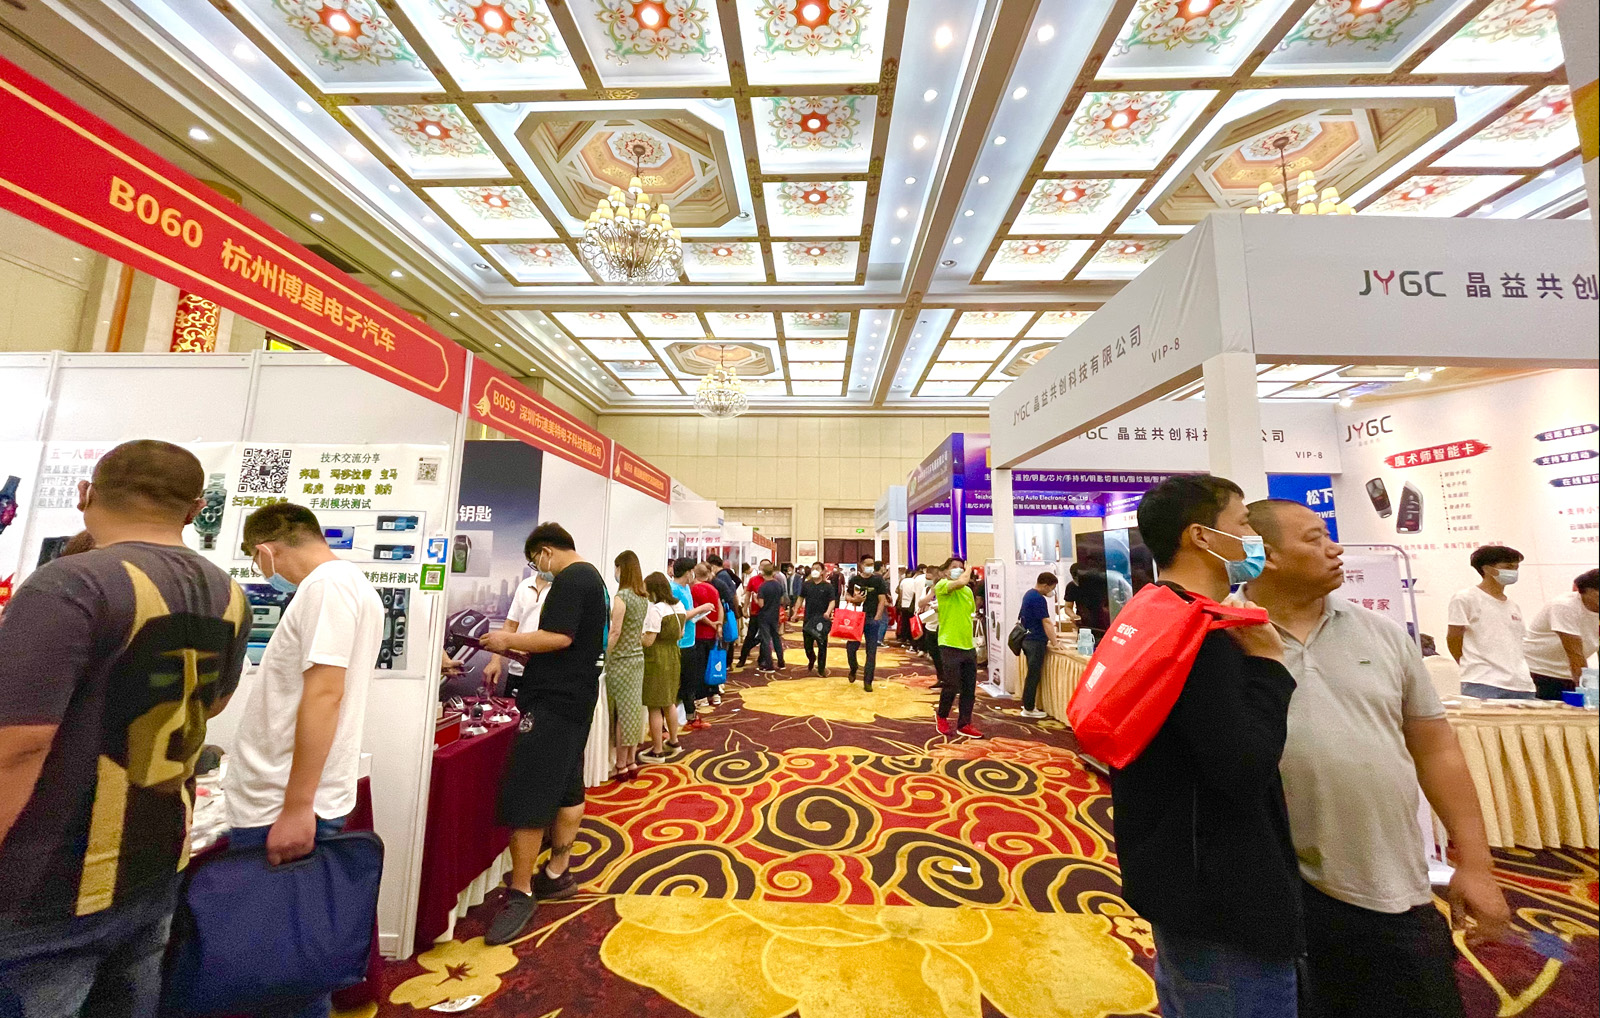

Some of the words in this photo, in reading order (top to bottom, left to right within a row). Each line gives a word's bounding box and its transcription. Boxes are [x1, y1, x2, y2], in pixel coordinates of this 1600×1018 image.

[108, 175, 203, 248] B060
[220, 238, 396, 353] 杭州博星电子汽车
[1359, 270, 1447, 297] JYGC
[1466, 271, 1599, 301] 晶益共创
[1151, 337, 1181, 363] VIP-8
[1013, 401, 1031, 426] JYGC
[1033, 324, 1142, 413] 晶益共创科技有限公司
[493, 389, 516, 414] B059
[1085, 426, 1109, 440] GC
[1345, 415, 1393, 442] JYGC
[320, 452, 381, 464] 技术交流分享
[1295, 451, 1324, 459] VIP-8
[1394, 443, 1474, 467] 魔术师智能卡
[299, 467, 320, 480] 奔驰
[379, 468, 398, 480] 宝马
[303, 482, 324, 495] 路虎
[334, 483, 366, 495] 保时捷
[1306, 487, 1333, 506] 松下
[309, 497, 371, 509] 手刹模块测试
[1039, 494, 1067, 502] Electronic
[456, 504, 493, 522] 钥匙
